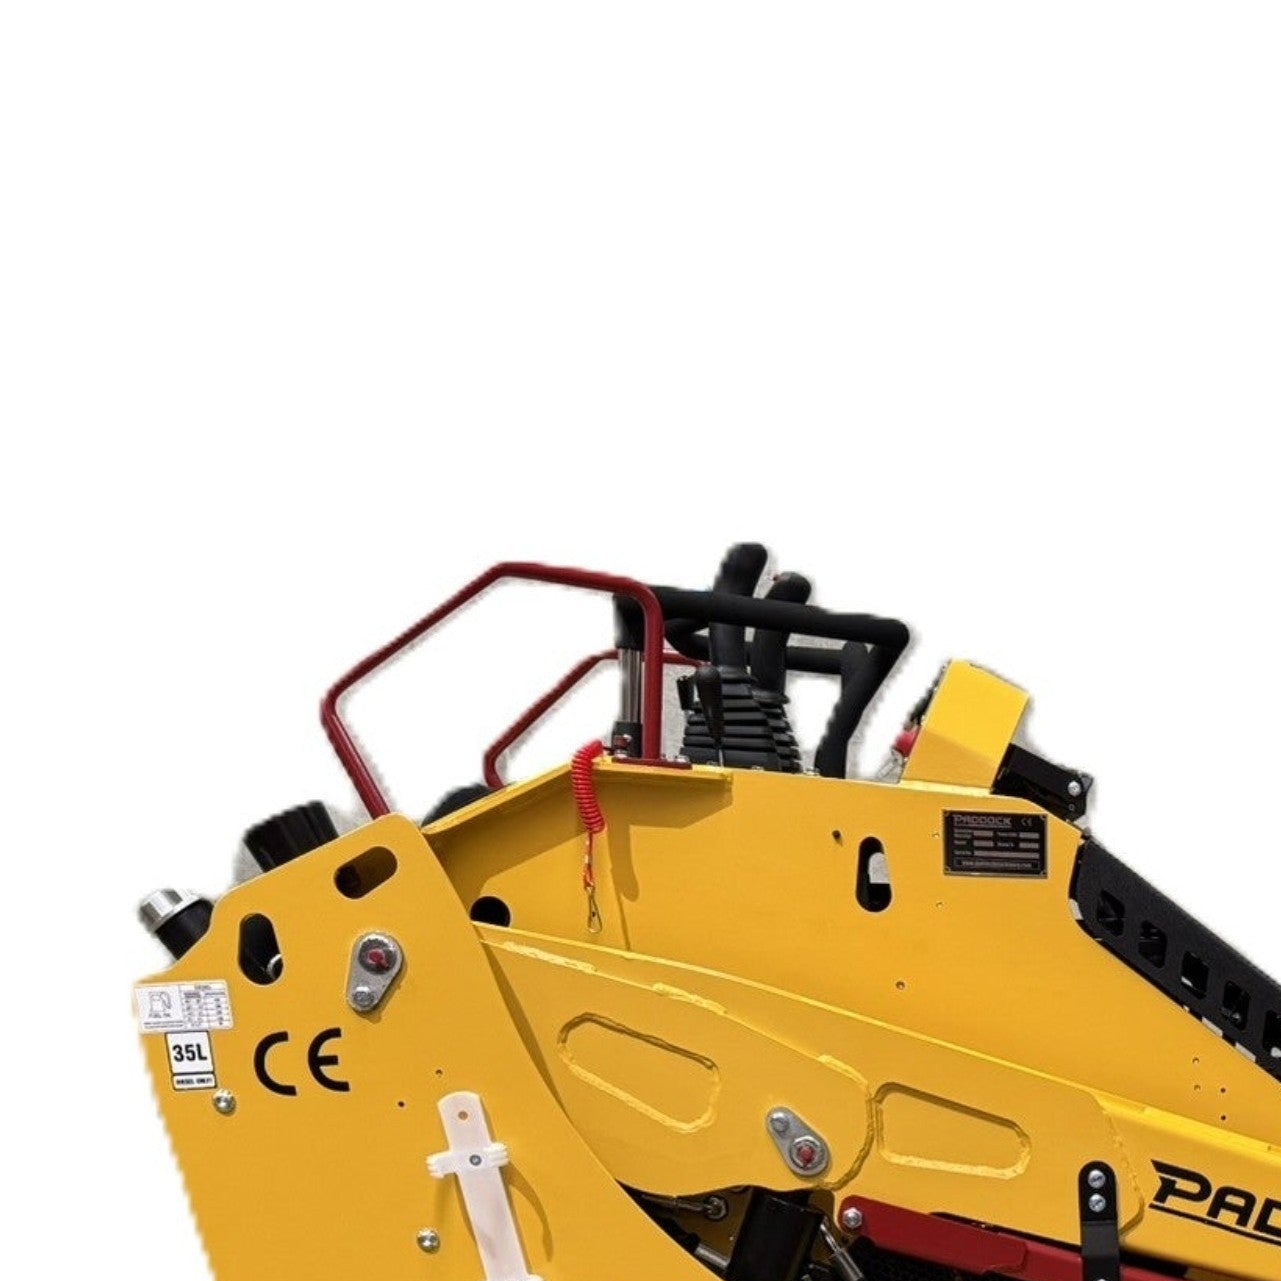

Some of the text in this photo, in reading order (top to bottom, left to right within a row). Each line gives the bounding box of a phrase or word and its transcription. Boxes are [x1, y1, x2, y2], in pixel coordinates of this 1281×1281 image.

[953, 814, 1012, 826] PADDOCK
[173, 1044, 207, 1062] 35L
[254, 1028, 350, 1096] CE
